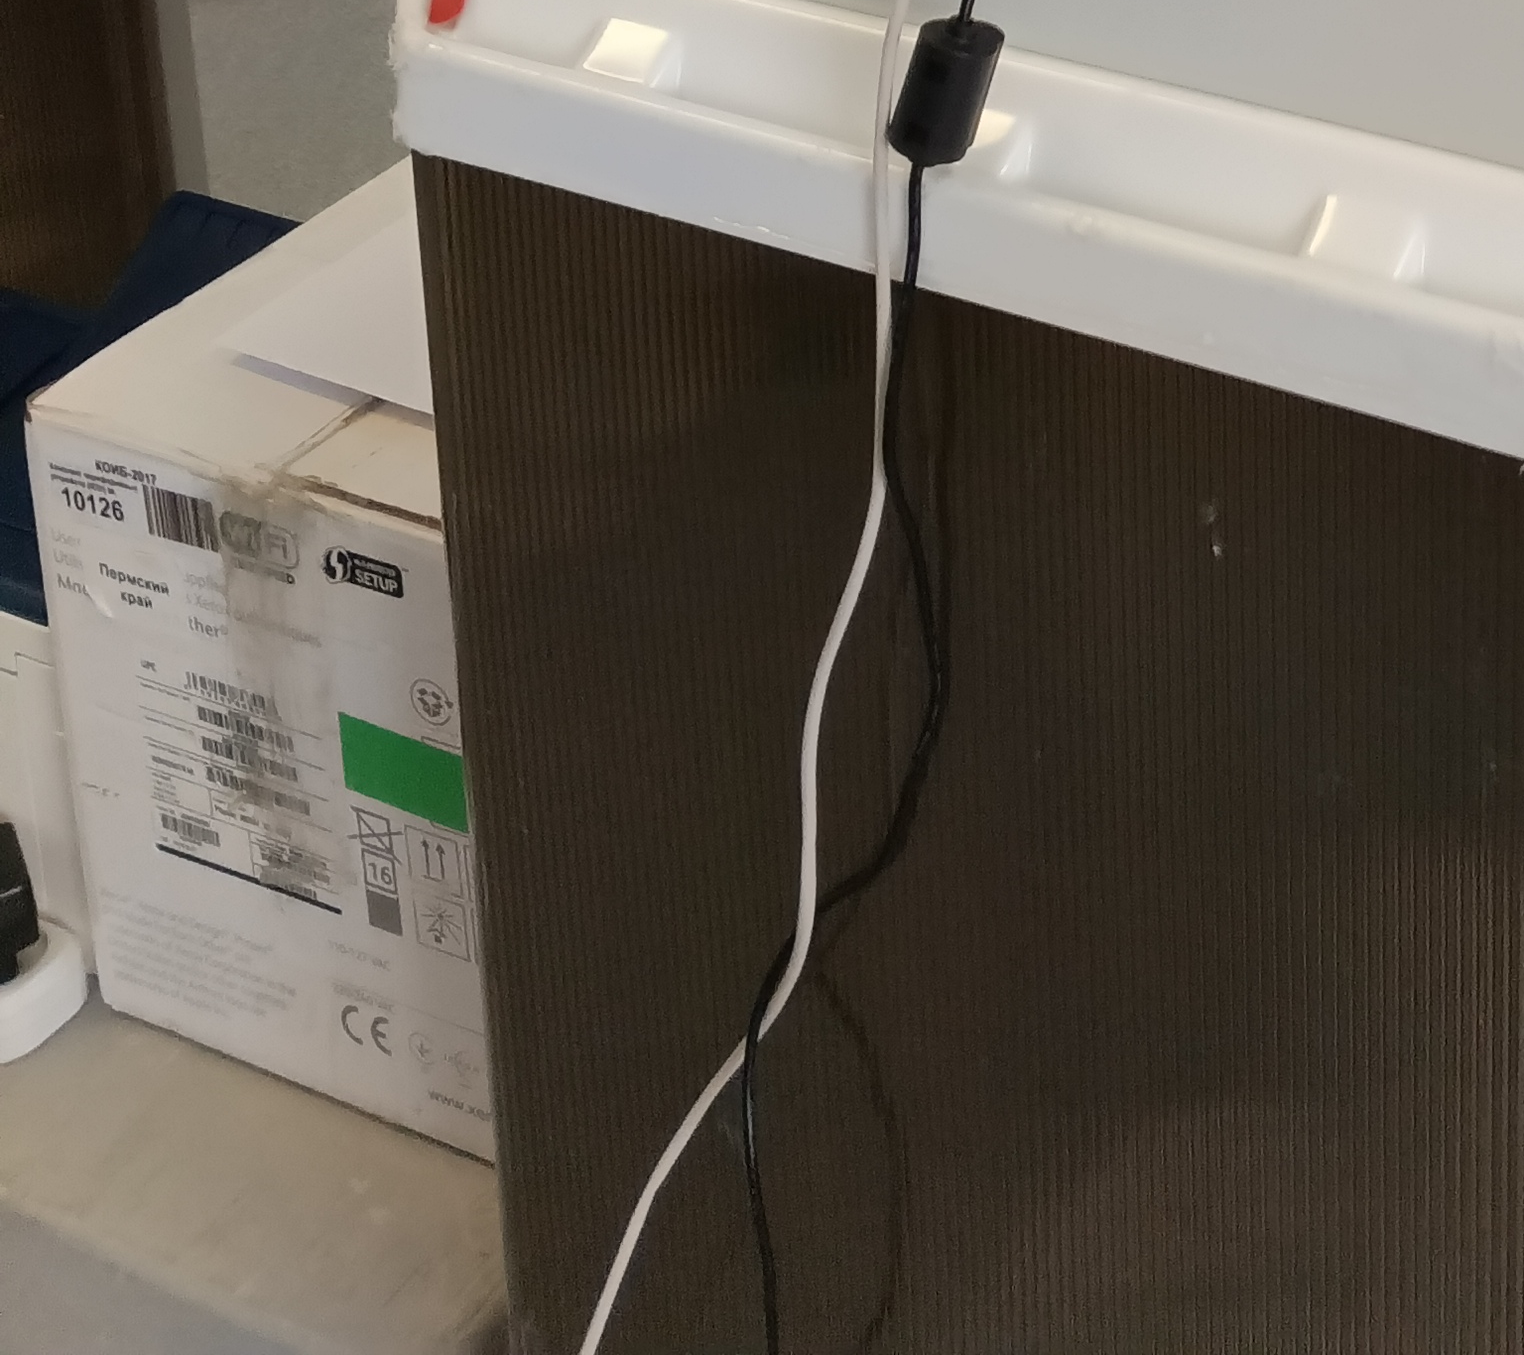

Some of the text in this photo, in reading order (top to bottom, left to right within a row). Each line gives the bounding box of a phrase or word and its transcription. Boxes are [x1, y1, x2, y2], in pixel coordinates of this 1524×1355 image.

[61, 486, 125, 522] 10126
[99, 562, 170, 596] Пермский
[355, 568, 398, 592] SETUP
[120, 590, 153, 610] край
